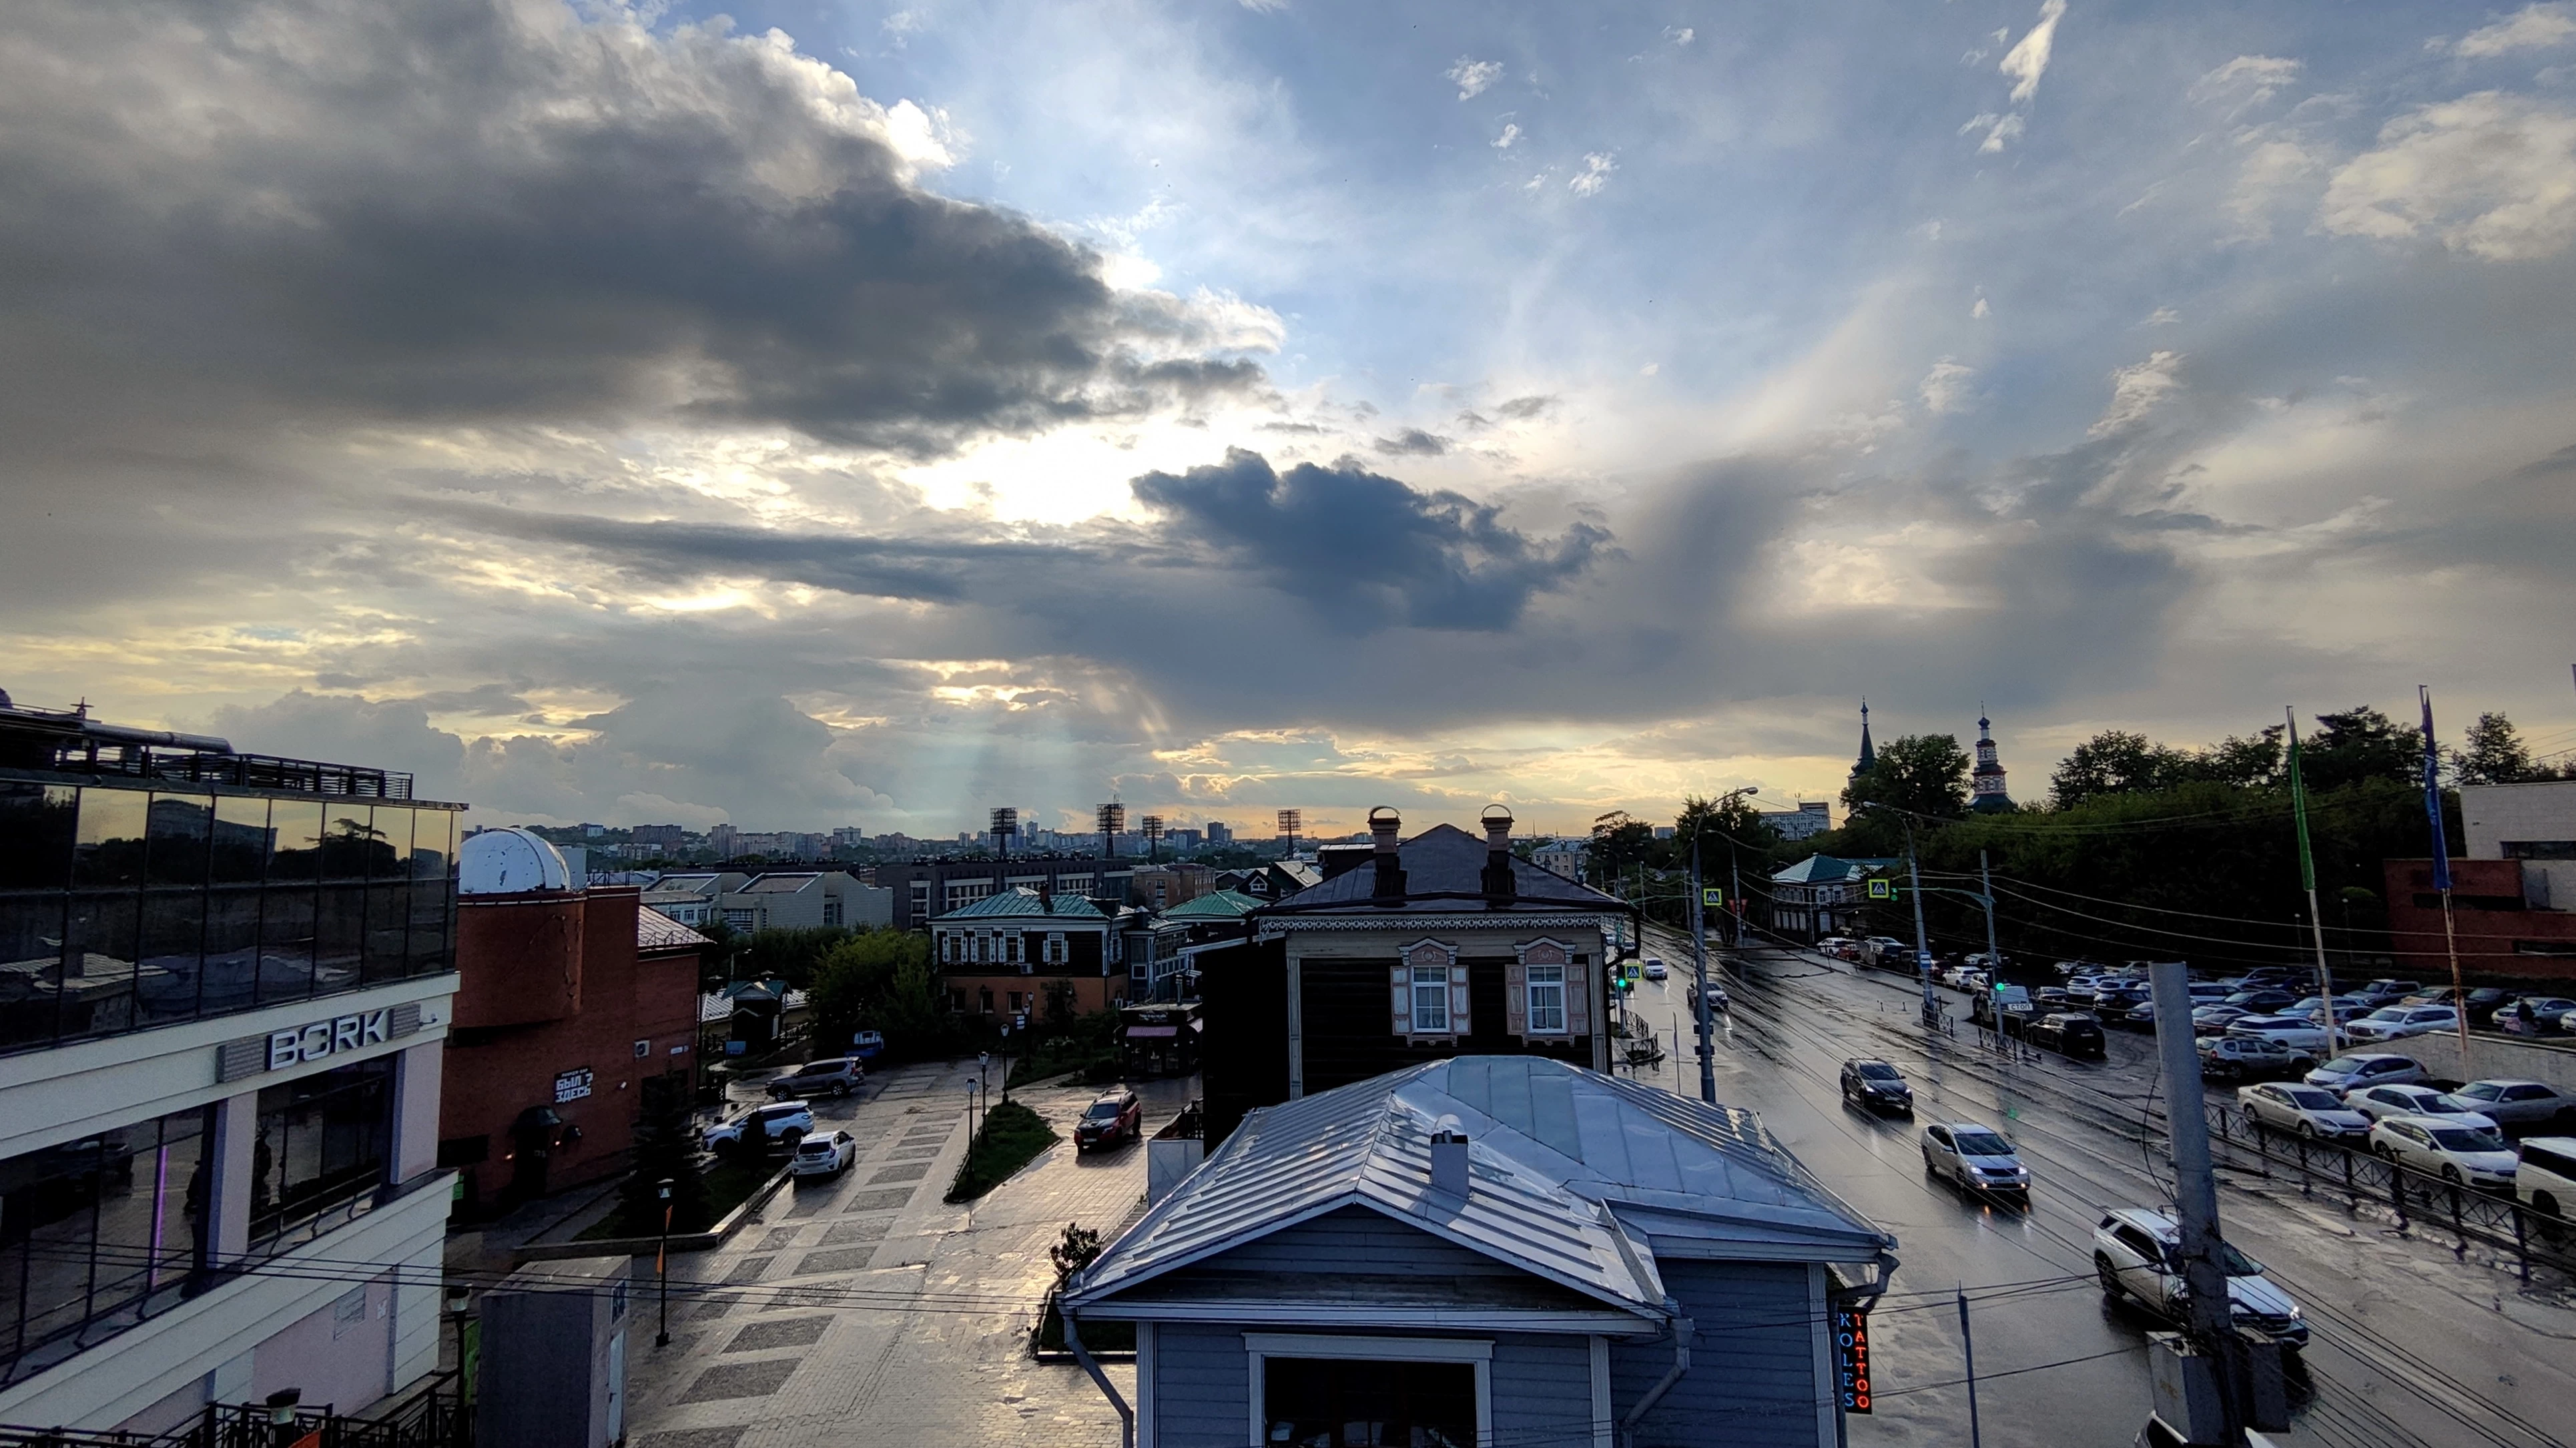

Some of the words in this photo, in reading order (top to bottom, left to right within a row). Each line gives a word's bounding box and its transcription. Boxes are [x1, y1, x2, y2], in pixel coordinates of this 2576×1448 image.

[270, 1009, 388, 1070] BORK
[555, 1086, 591, 1103] ЗДЕСЬ
[556, 1075, 581, 1091] БЫЛ
[1840, 1313, 1855, 1407] KOLES
[1854, 1313, 1869, 1408] TATTOO
